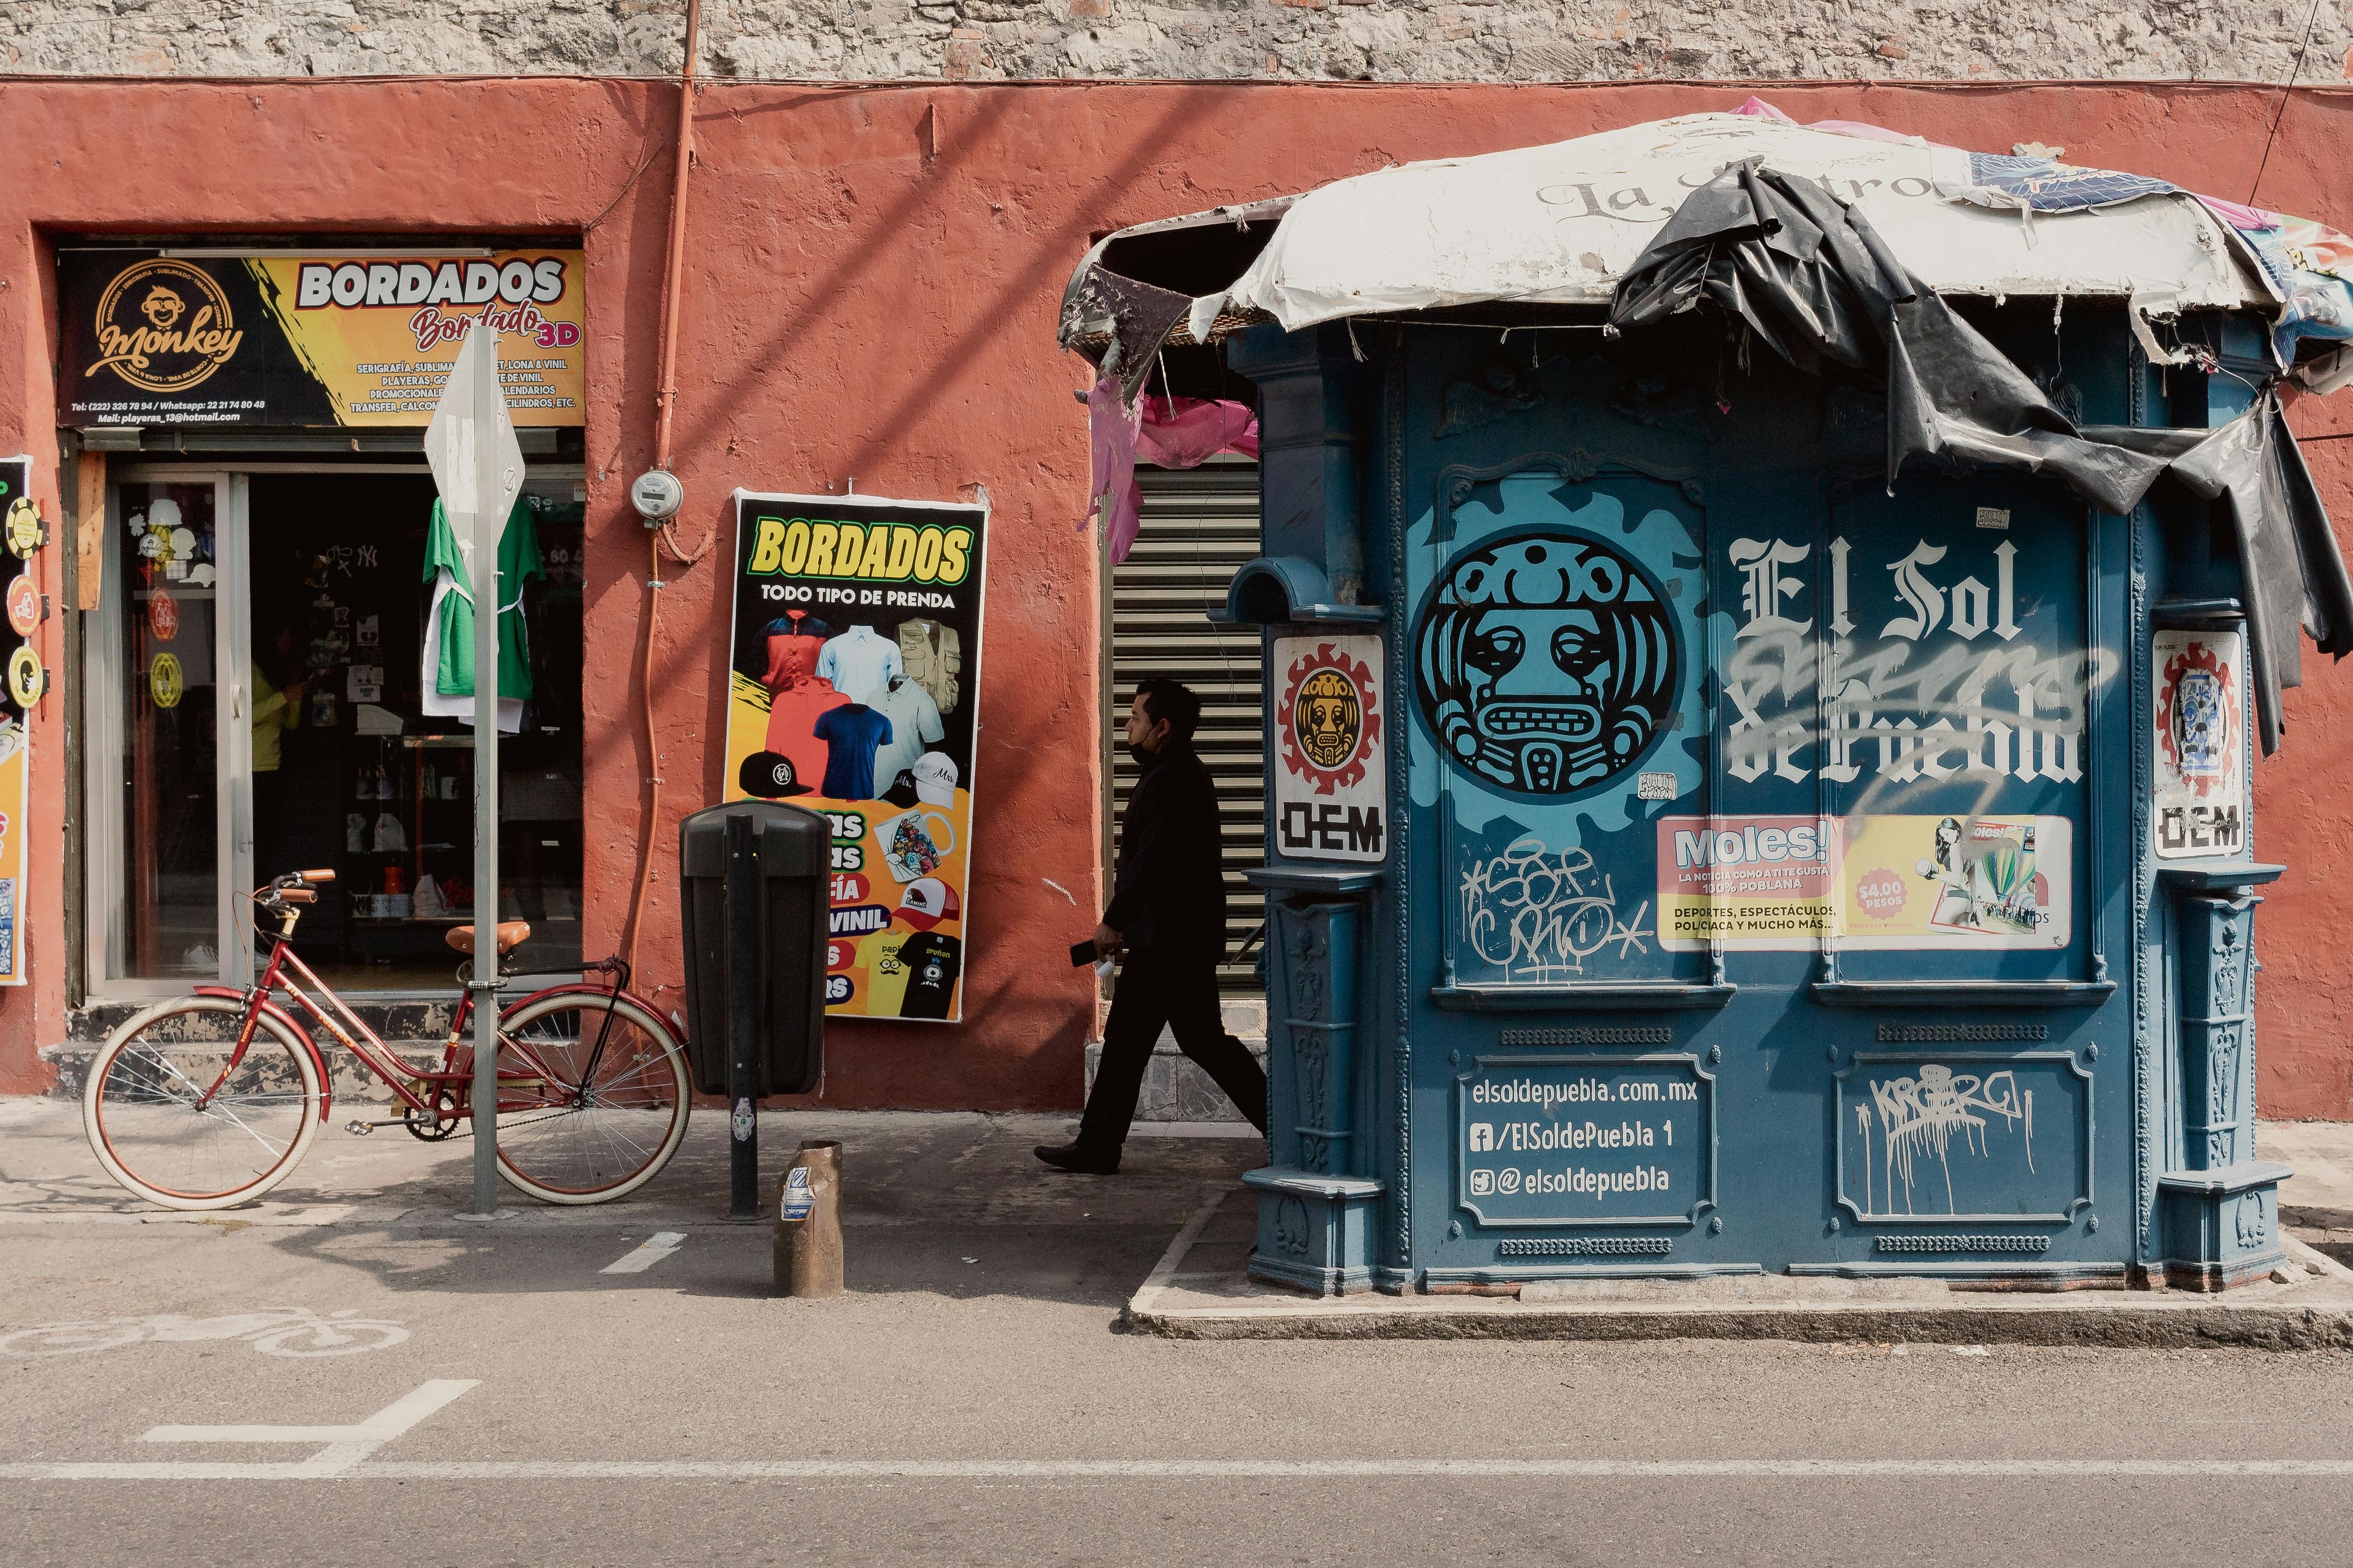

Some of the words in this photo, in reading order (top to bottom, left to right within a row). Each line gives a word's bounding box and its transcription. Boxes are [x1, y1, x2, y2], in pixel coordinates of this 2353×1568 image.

[298, 260, 565, 308] BORDADOS
[411, 299, 543, 351] Bordado
[536, 322, 580, 347] 3D
[85, 305, 244, 377] Monkey
[357, 361, 414, 374] SERIGRAFÍA,
[415, 362, 455, 372] SUBLIMA
[544, 359, 567, 369] VINIL
[382, 376, 433, 386] PLAYERAS,
[507, 373, 519, 383] DE
[519, 372, 544, 382] VINIL
[370, 388, 444, 399] PROMOCIONALE
[501, 385, 556, 395] ALENDARIOS
[88, 402, 110, 411] (222)
[112, 402, 128, 411] 326
[141, 402, 152, 410] 94
[160, 401, 205, 411] Whatsapp:
[207, 401, 217, 409] 22
[218, 401, 228, 409] 21
[229, 401, 240, 409] 74
[350, 402, 399, 413] TRANSFER,
[401, 401, 439, 411] CALCOM
[505, 397, 555, 408] CILINDROS,
[556, 397, 576, 408] ETC.
[98, 414, 120, 423] Mail:
[121, 413, 240, 424] playeras_13@hotmail.com
[749, 519, 971, 584] BORDADOS
[762, 585, 812, 602] TODO
[816, 587, 856, 604] TIPO
[860, 590, 882, 605] DE
[887, 591, 955, 608] PRENDA
[1729, 536, 1856, 641] El
[1879, 539, 2023, 641] Sol
[895, 775, 912, 788] Mr.
[933, 768, 954, 784] Mrs.
[1280, 801, 1383, 854] OEM
[1972, 827, 2005, 838] oles!
[2158, 805, 2240, 849] OEM
[1674, 820, 1830, 869] Moles!
[1678, 873, 1693, 883] LA
[1694, 871, 1732, 882] NOTICIA
[1733, 870, 1763, 880] COMO
[1796, 866, 1829, 876] GUSTA
[1703, 883, 1737, 894] 100%
[1739, 878, 1803, 892] POBLANA
[1859, 881, 1901, 900] $4.00
[907, 898, 927, 908] GAMING
[1866, 896, 1902, 909] PESOS
[1674, 908, 1737, 918] DEPORTES,
[1741, 904, 1836, 916] ESPECTÁCULOS,
[830, 909, 886, 932] VINIL
[1675, 921, 1734, 930] POLICIACA
[1737, 921, 1744, 930] Y
[1748, 920, 1795, 929] MUCHO
[1799, 917, 1833, 929] MÁS...
[241, 1019, 253, 1043] NITRO
[1473, 1078, 1697, 1109] elsoldepuebla.com.mx
